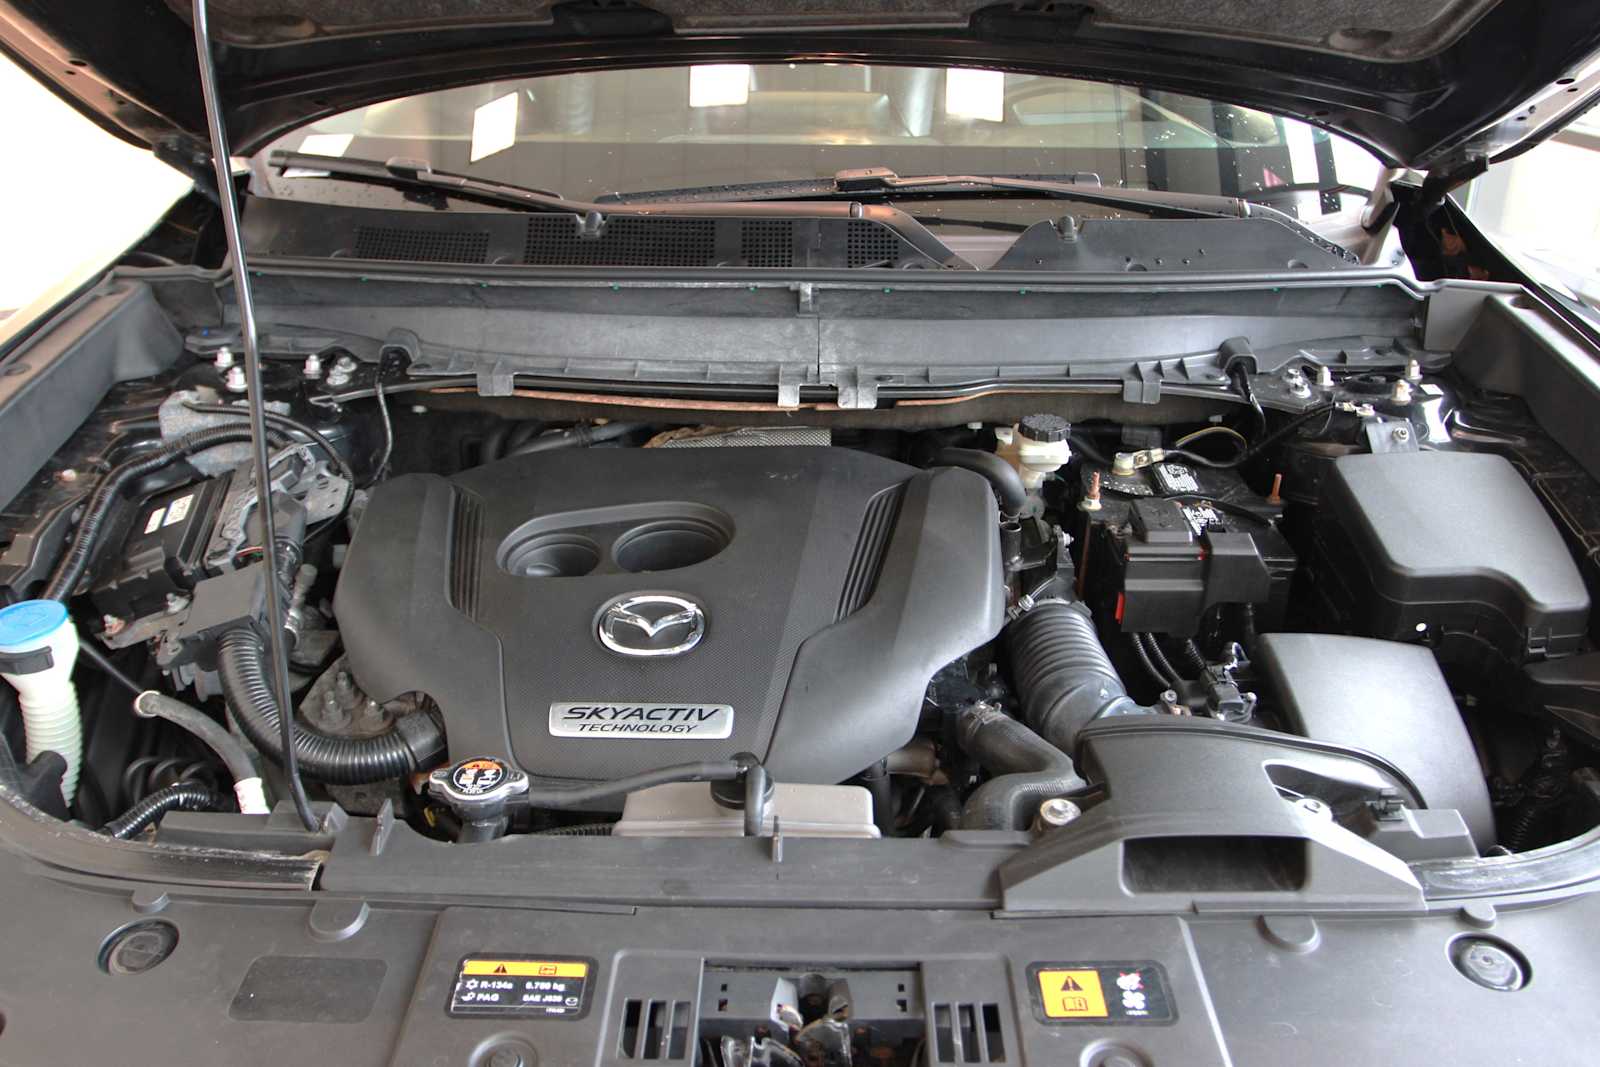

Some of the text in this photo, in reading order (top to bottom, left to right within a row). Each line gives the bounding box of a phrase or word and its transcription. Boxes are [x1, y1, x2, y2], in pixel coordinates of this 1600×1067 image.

[562, 706, 720, 722] SKYACTIV
[578, 723, 699, 734] TECHNOLOGY
[480, 980, 513, 990] R-134a
[476, 993, 500, 1002] PAG
